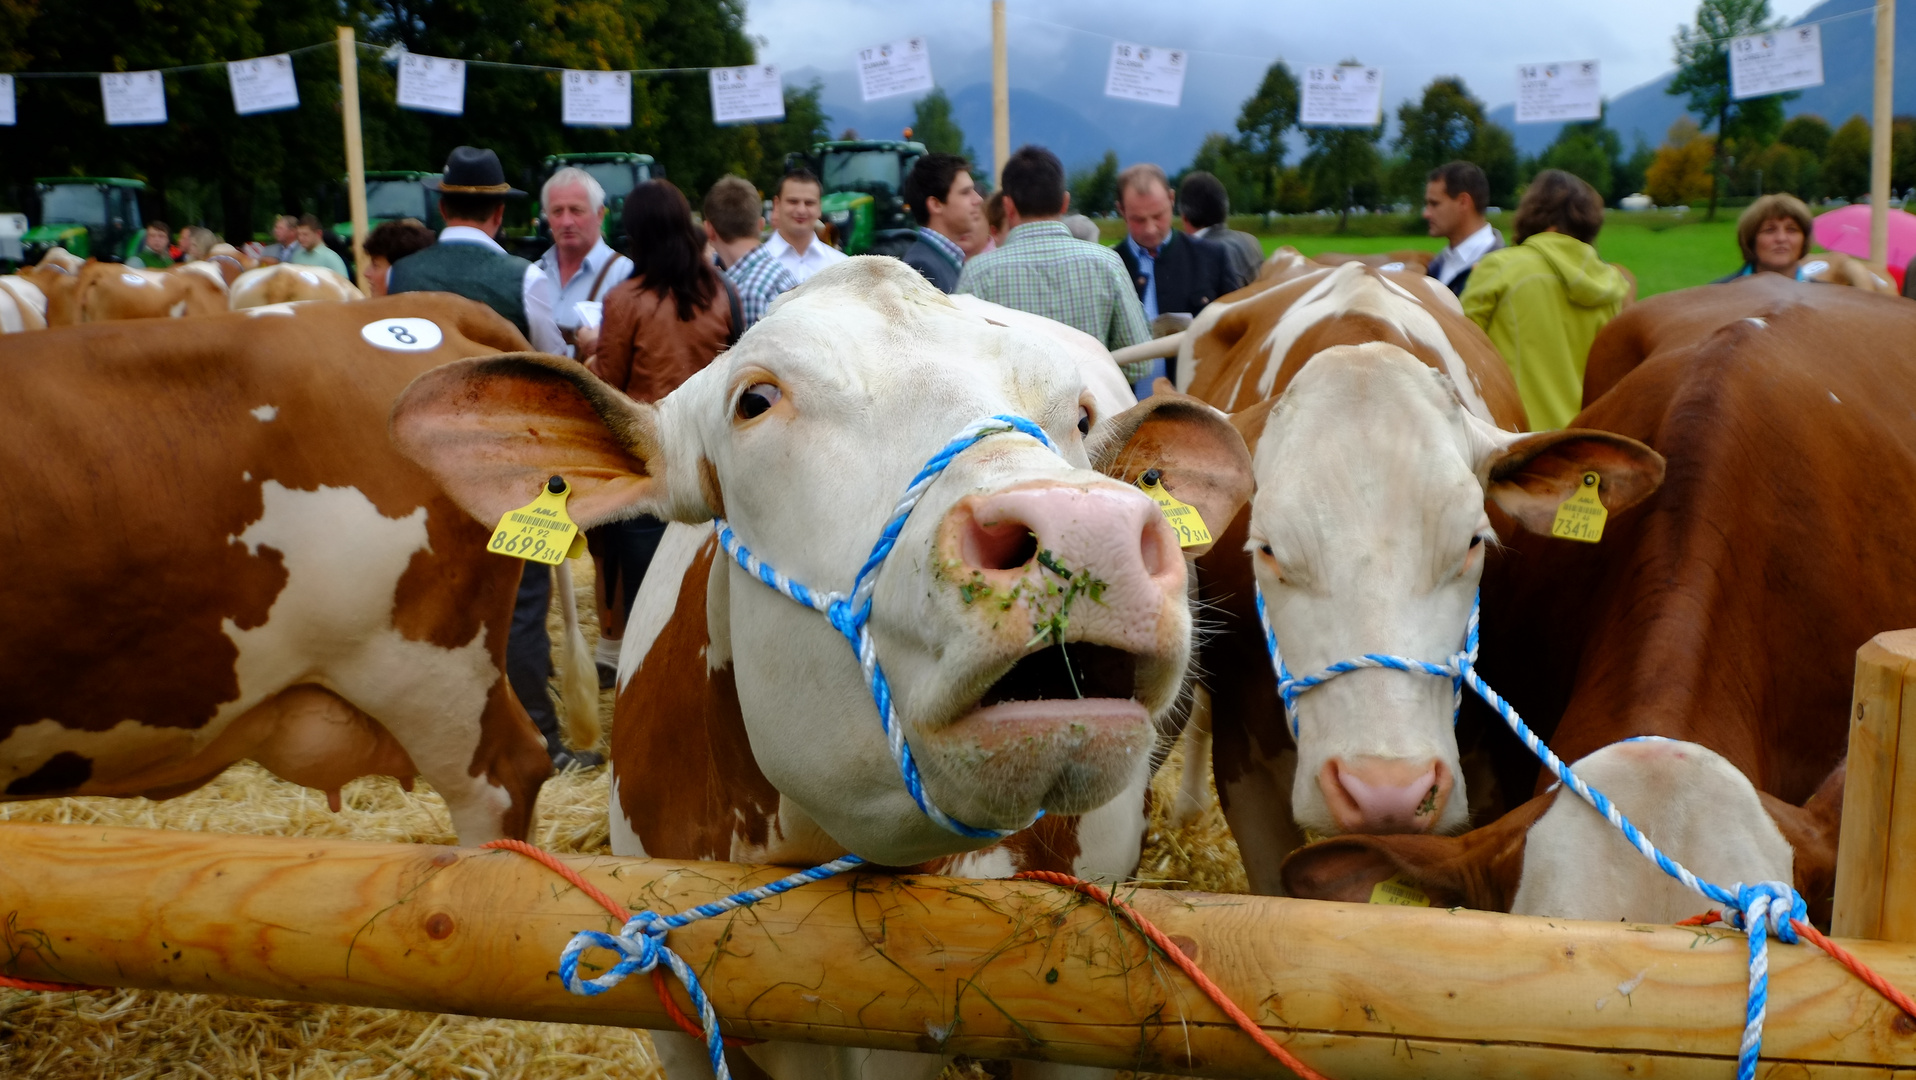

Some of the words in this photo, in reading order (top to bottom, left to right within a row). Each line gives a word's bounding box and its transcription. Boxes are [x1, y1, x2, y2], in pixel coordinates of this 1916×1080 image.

[1117, 45, 1131, 57] 16
[1735, 39, 1752, 52] 13
[859, 48, 873, 60] 17
[715, 70, 729, 81] 18
[1309, 68, 1325, 80] 15
[1521, 66, 1537, 79] 14
[387, 325, 419, 345] 8
[1172, 517, 1184, 525] 92
[521, 526, 534, 534] AT
[537, 530, 550, 538] 92
[1554, 518, 1589, 538] 7341
[491, 531, 547, 557] 8699
[541, 548, 563, 562] 314
[1389, 896, 1398, 904] AT
